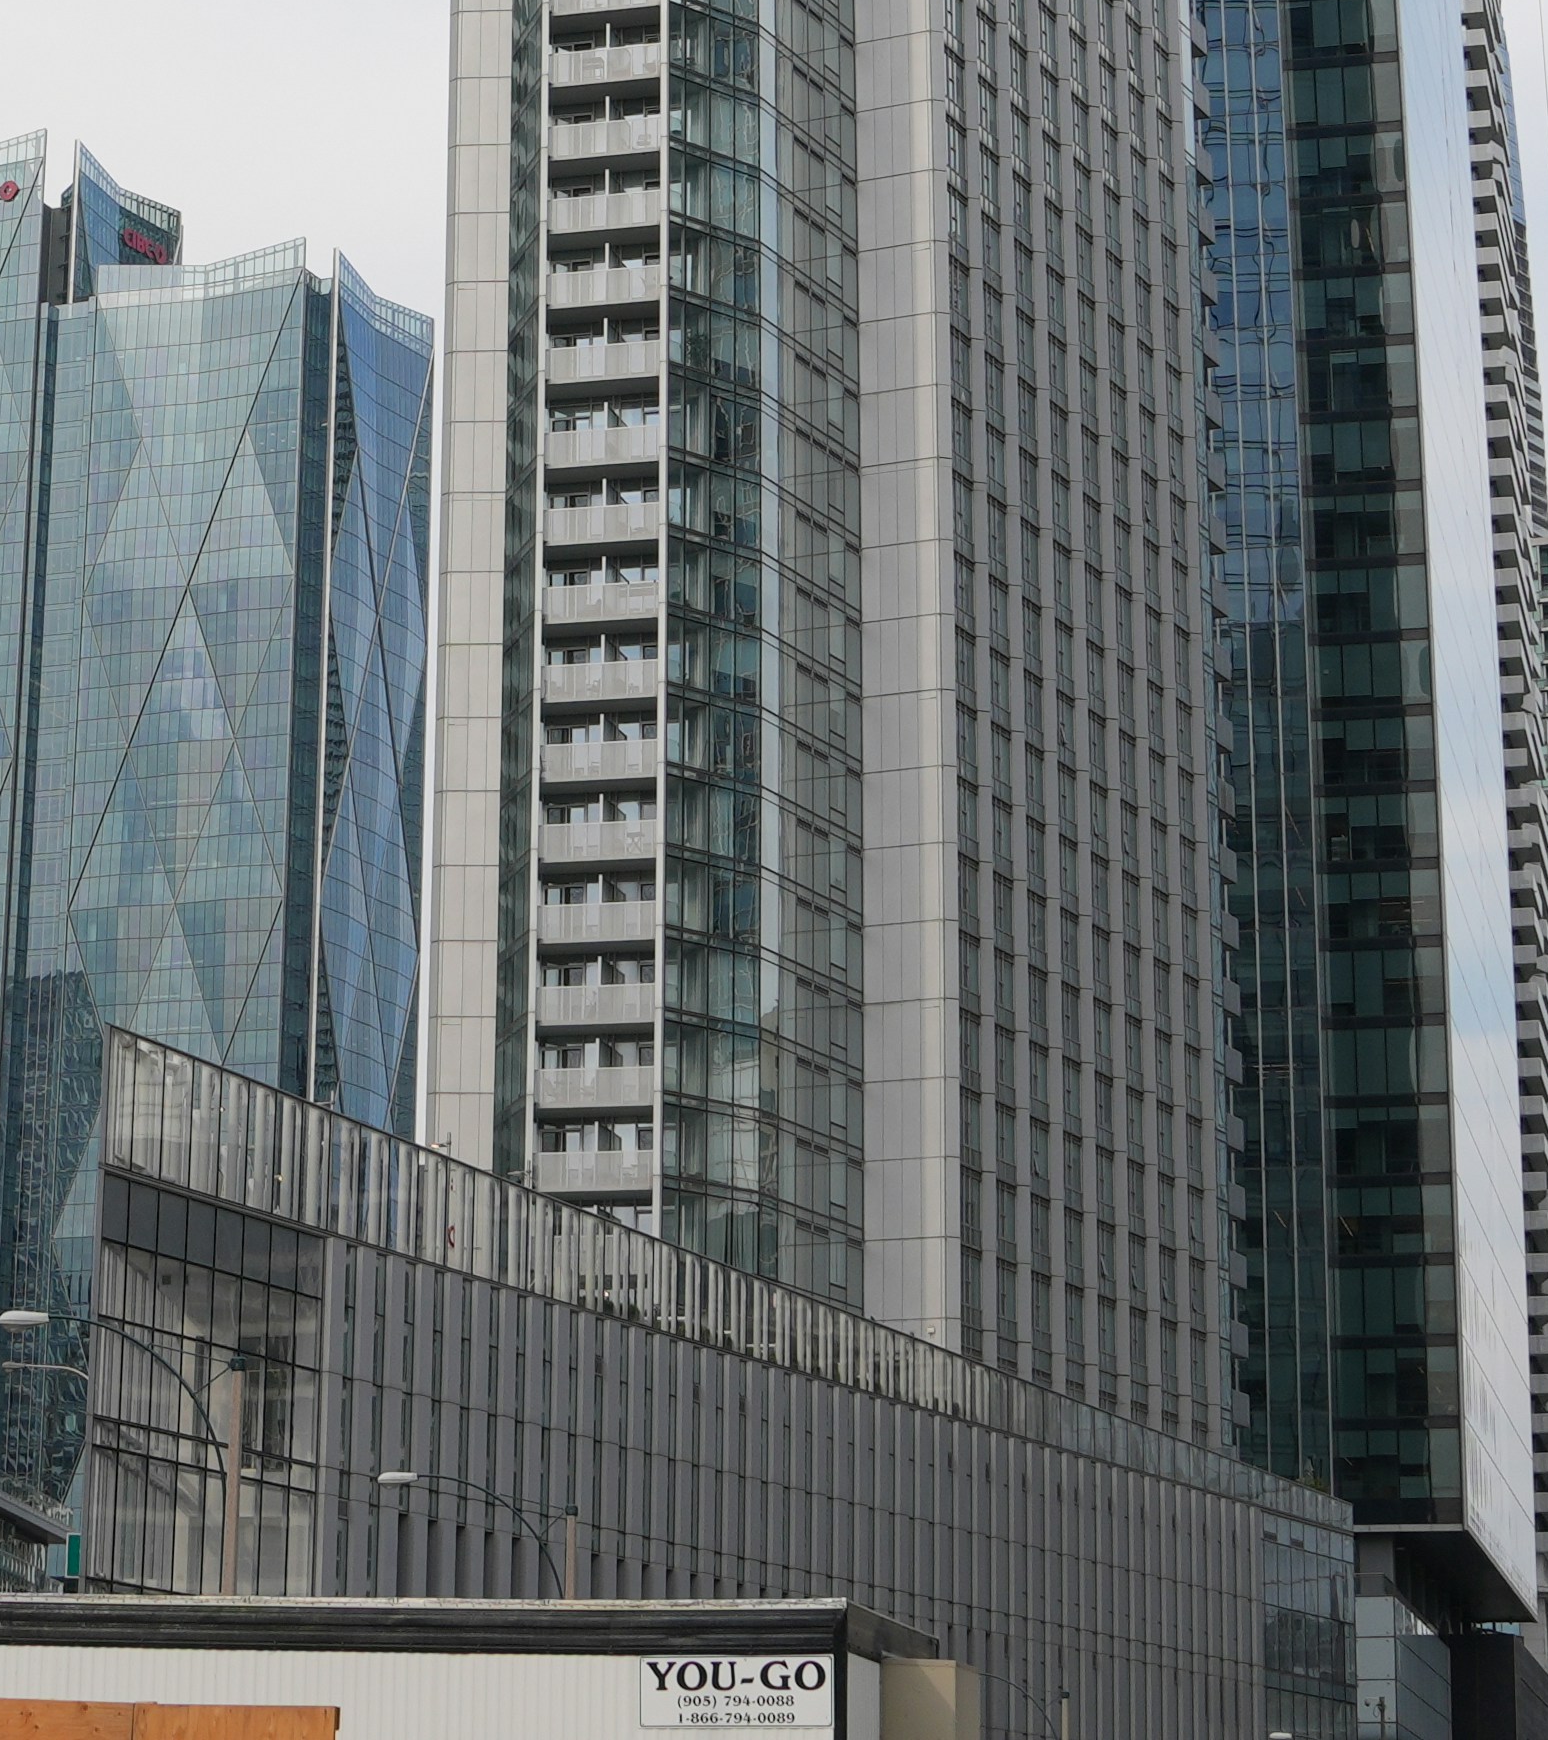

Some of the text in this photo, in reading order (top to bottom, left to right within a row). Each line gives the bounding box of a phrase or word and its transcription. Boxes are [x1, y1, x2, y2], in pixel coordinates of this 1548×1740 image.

[646, 1660, 826, 1691] YOU-GO
[677, 1695, 795, 1709] (905) 794-0088
[678, 1712, 795, 1725] 1-866-794-0089
